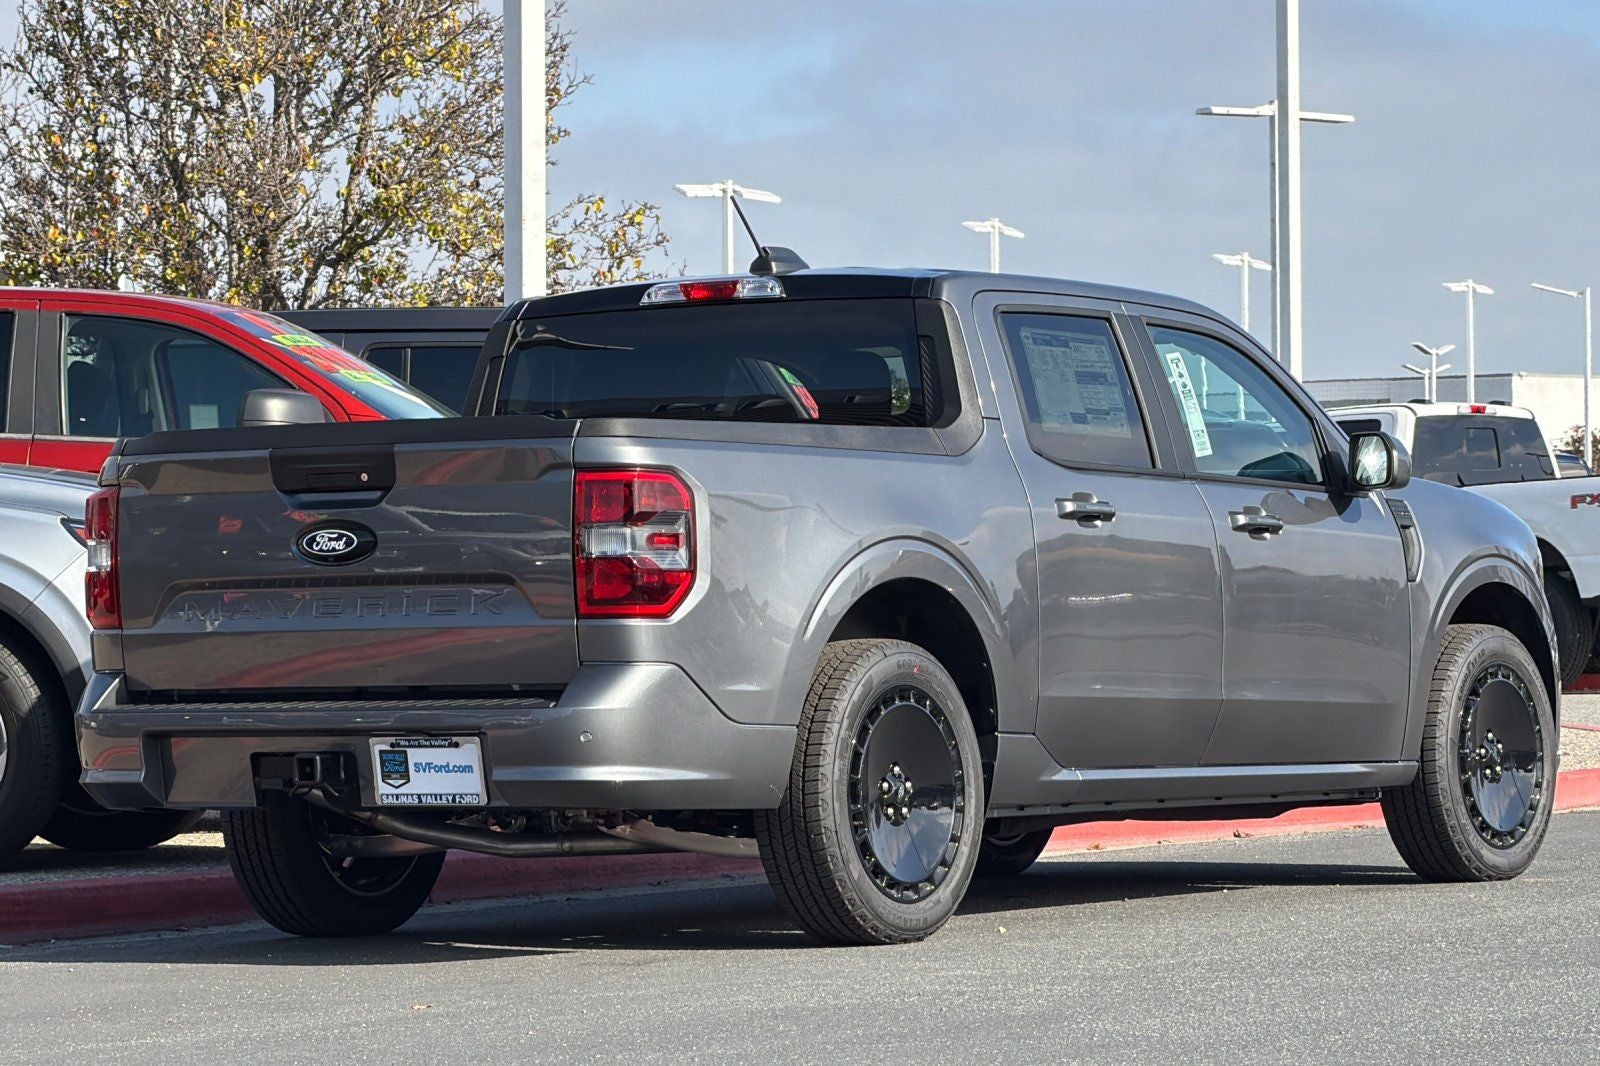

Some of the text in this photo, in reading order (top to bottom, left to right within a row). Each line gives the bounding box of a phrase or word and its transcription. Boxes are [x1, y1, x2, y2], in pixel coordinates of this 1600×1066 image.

[313, 533, 346, 550] Ford
[183, 591, 506, 622] MAVERICK
[430, 739, 452, 747] Valley"
[413, 762, 474, 774] SVFord.com
[381, 794, 479, 804] SALINAS VALLEY FORD
